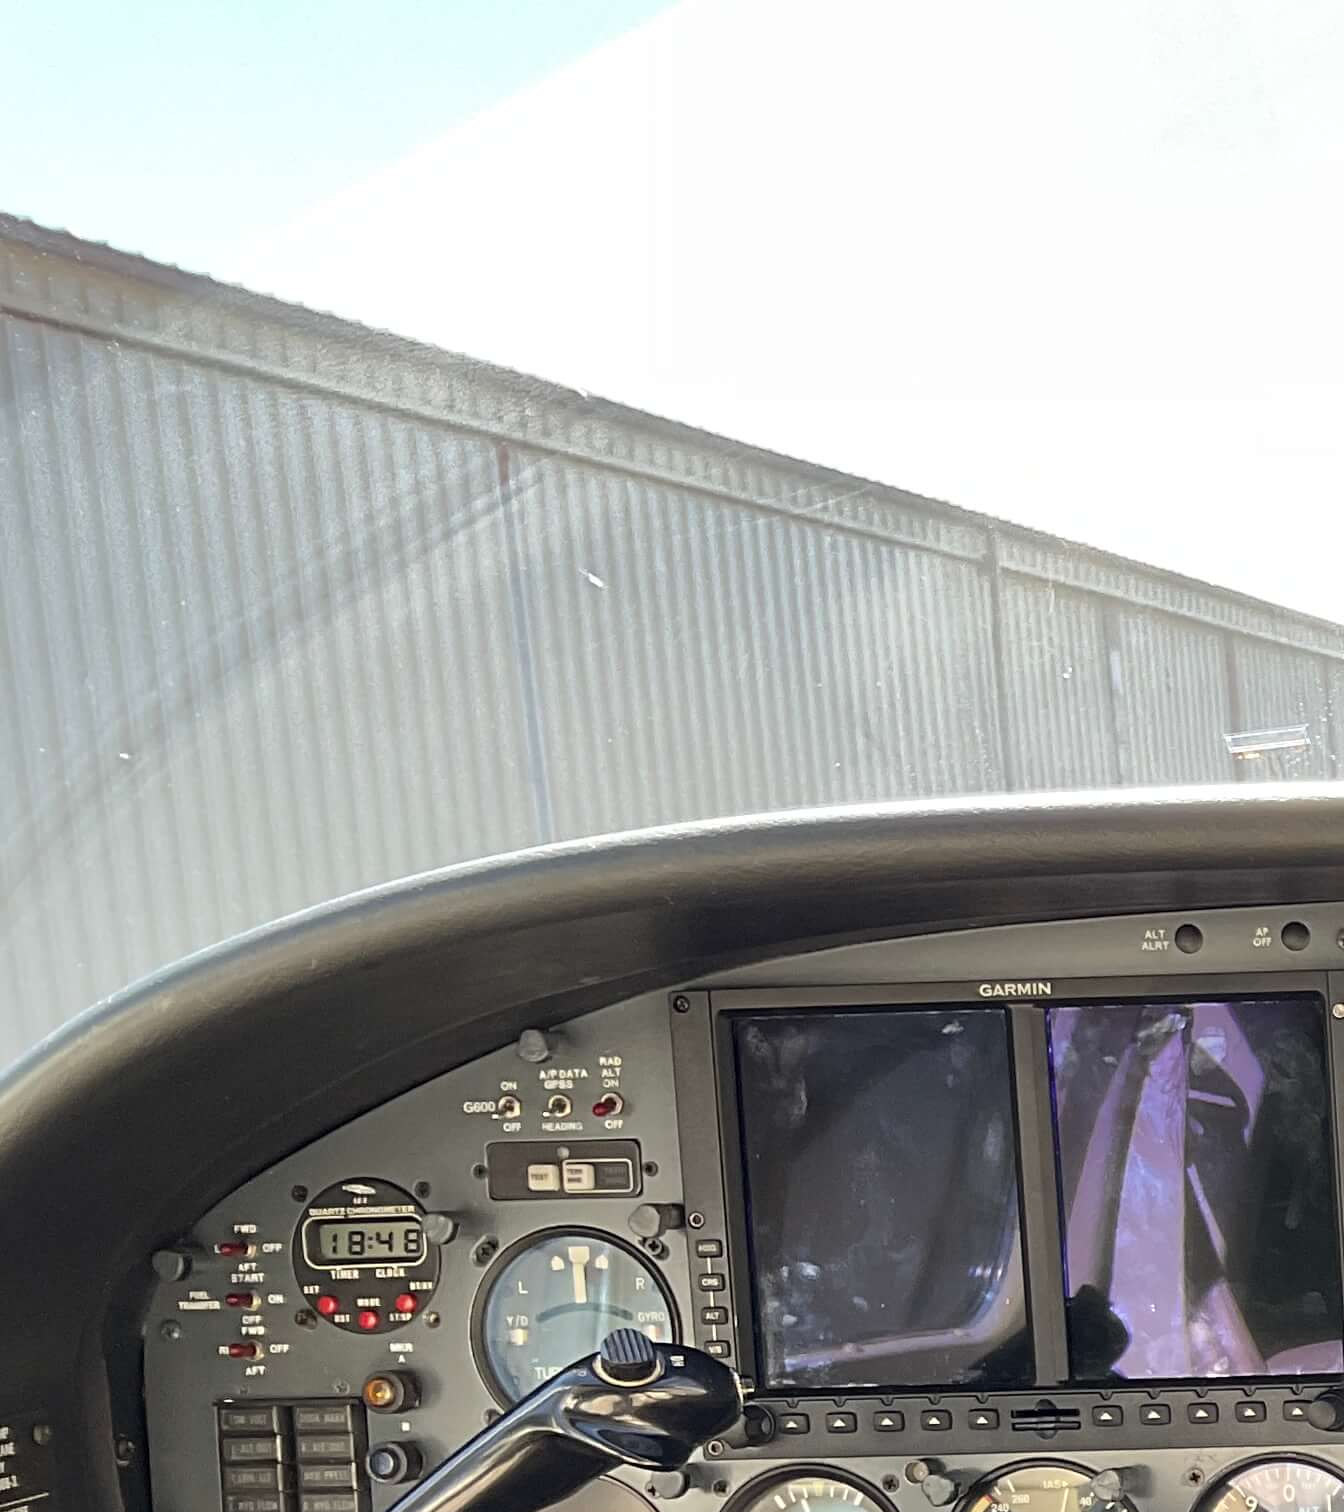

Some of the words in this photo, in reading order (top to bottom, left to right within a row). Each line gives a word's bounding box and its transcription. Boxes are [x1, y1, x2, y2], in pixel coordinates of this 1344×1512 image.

[978, 982, 1052, 998] GARMIN
[463, 1101, 496, 1114] G600
[329, 1228, 422, 1257] 18:48
